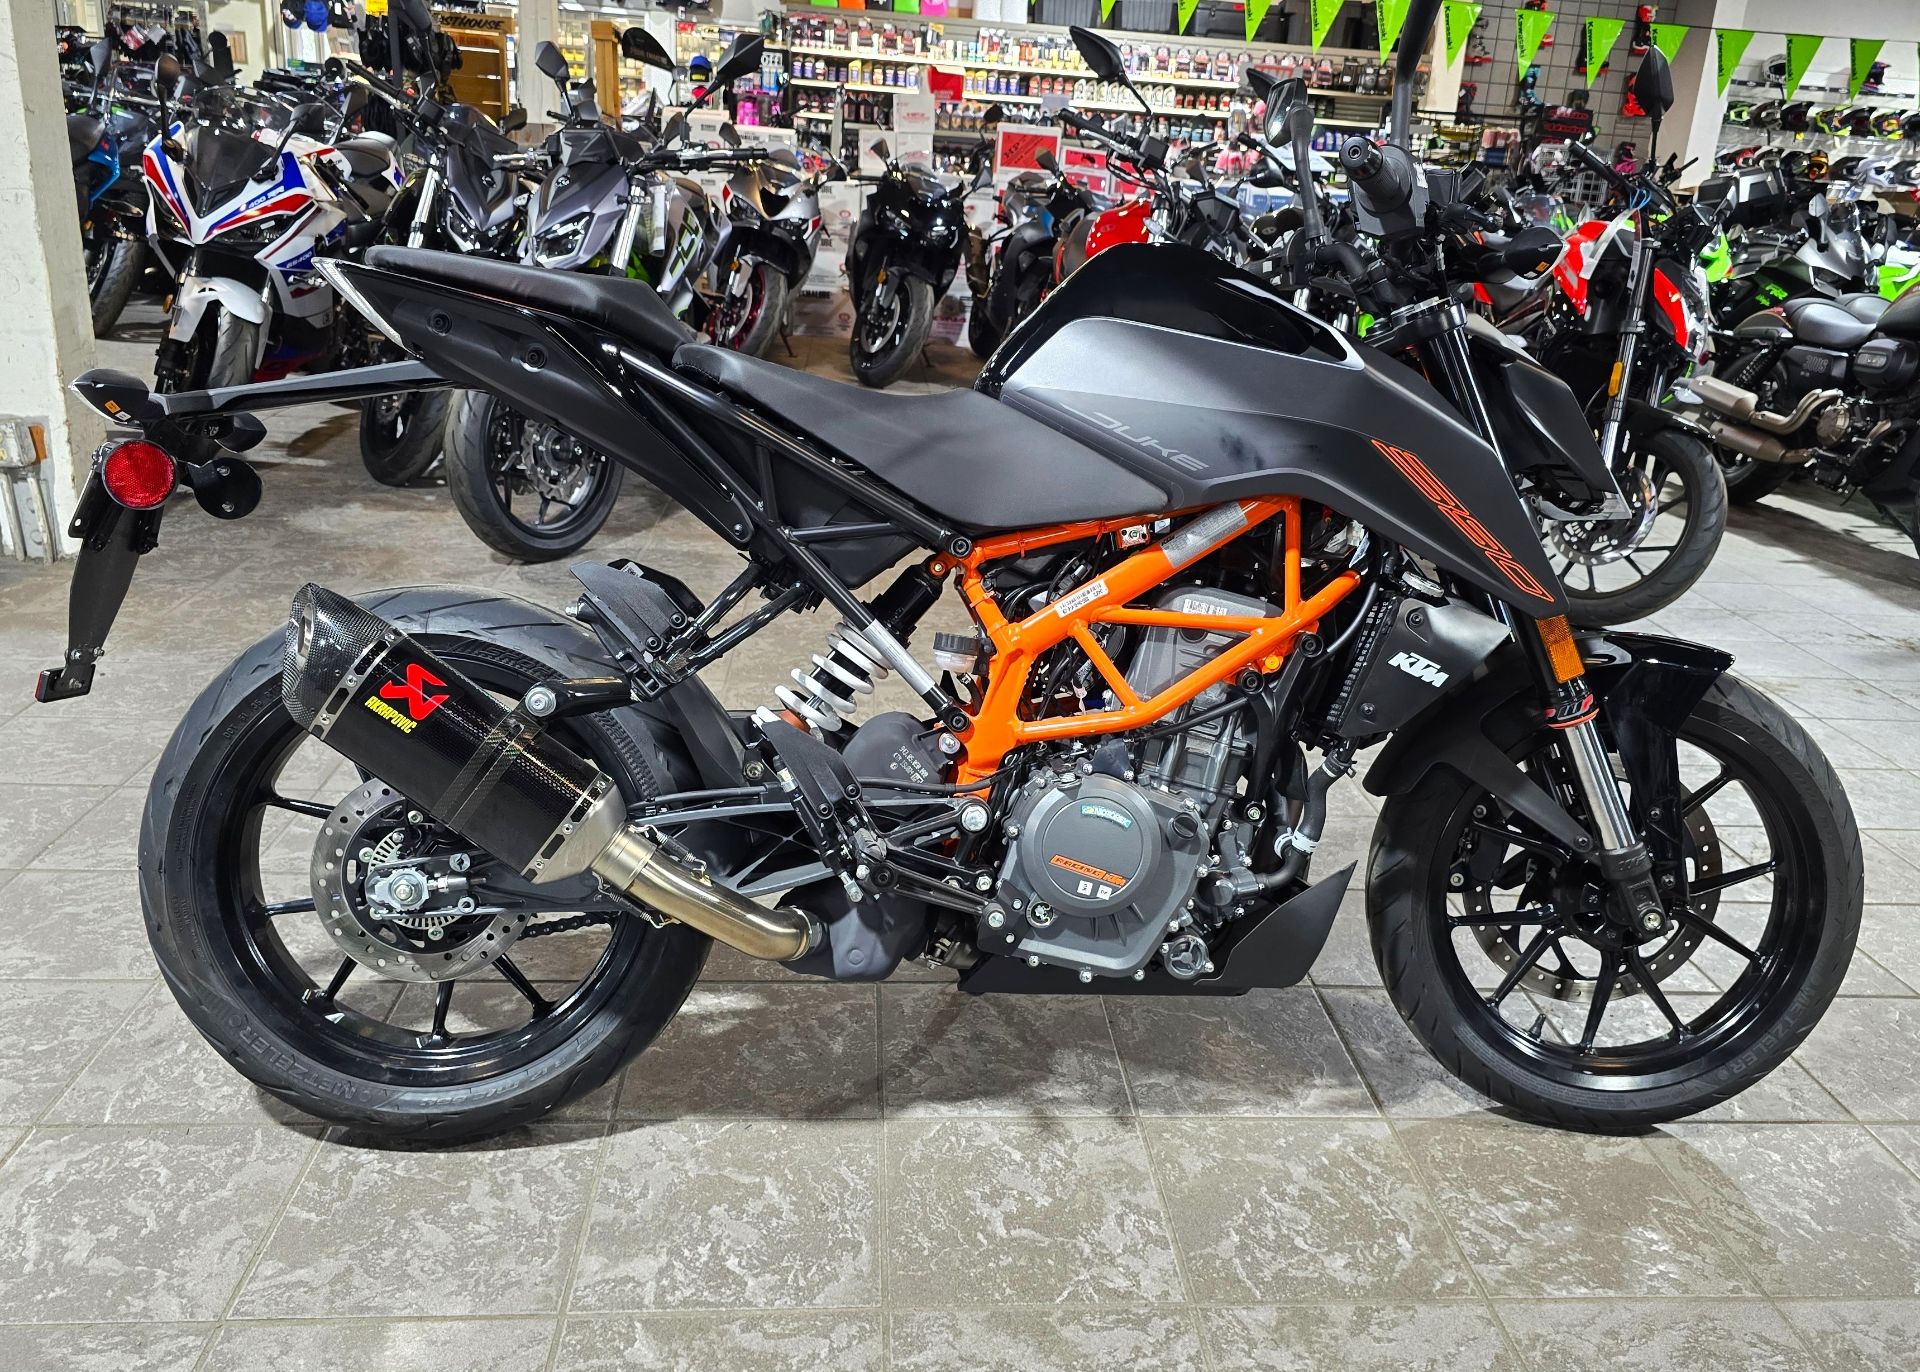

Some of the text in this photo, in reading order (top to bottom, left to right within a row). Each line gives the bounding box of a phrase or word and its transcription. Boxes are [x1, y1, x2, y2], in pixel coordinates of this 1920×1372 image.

[1444, 5, 1453, 50] Kawasaki
[1517, 14, 1526, 58] Kawasaki
[1587, 21, 1595, 66] Kawasaki
[1717, 33, 1725, 77] Kawasaki
[1786, 38, 1794, 82] Kawasaki
[1850, 39, 1858, 81] Kawasaki
[248, 195, 267, 209] 400
[1061, 403, 1210, 471] DUKE
[1387, 651, 1450, 688] KTM
[1054, 857, 1101, 878] RACING
[1732, 987, 1811, 1074] METZELER
[239, 1025, 357, 1099] METZELER
